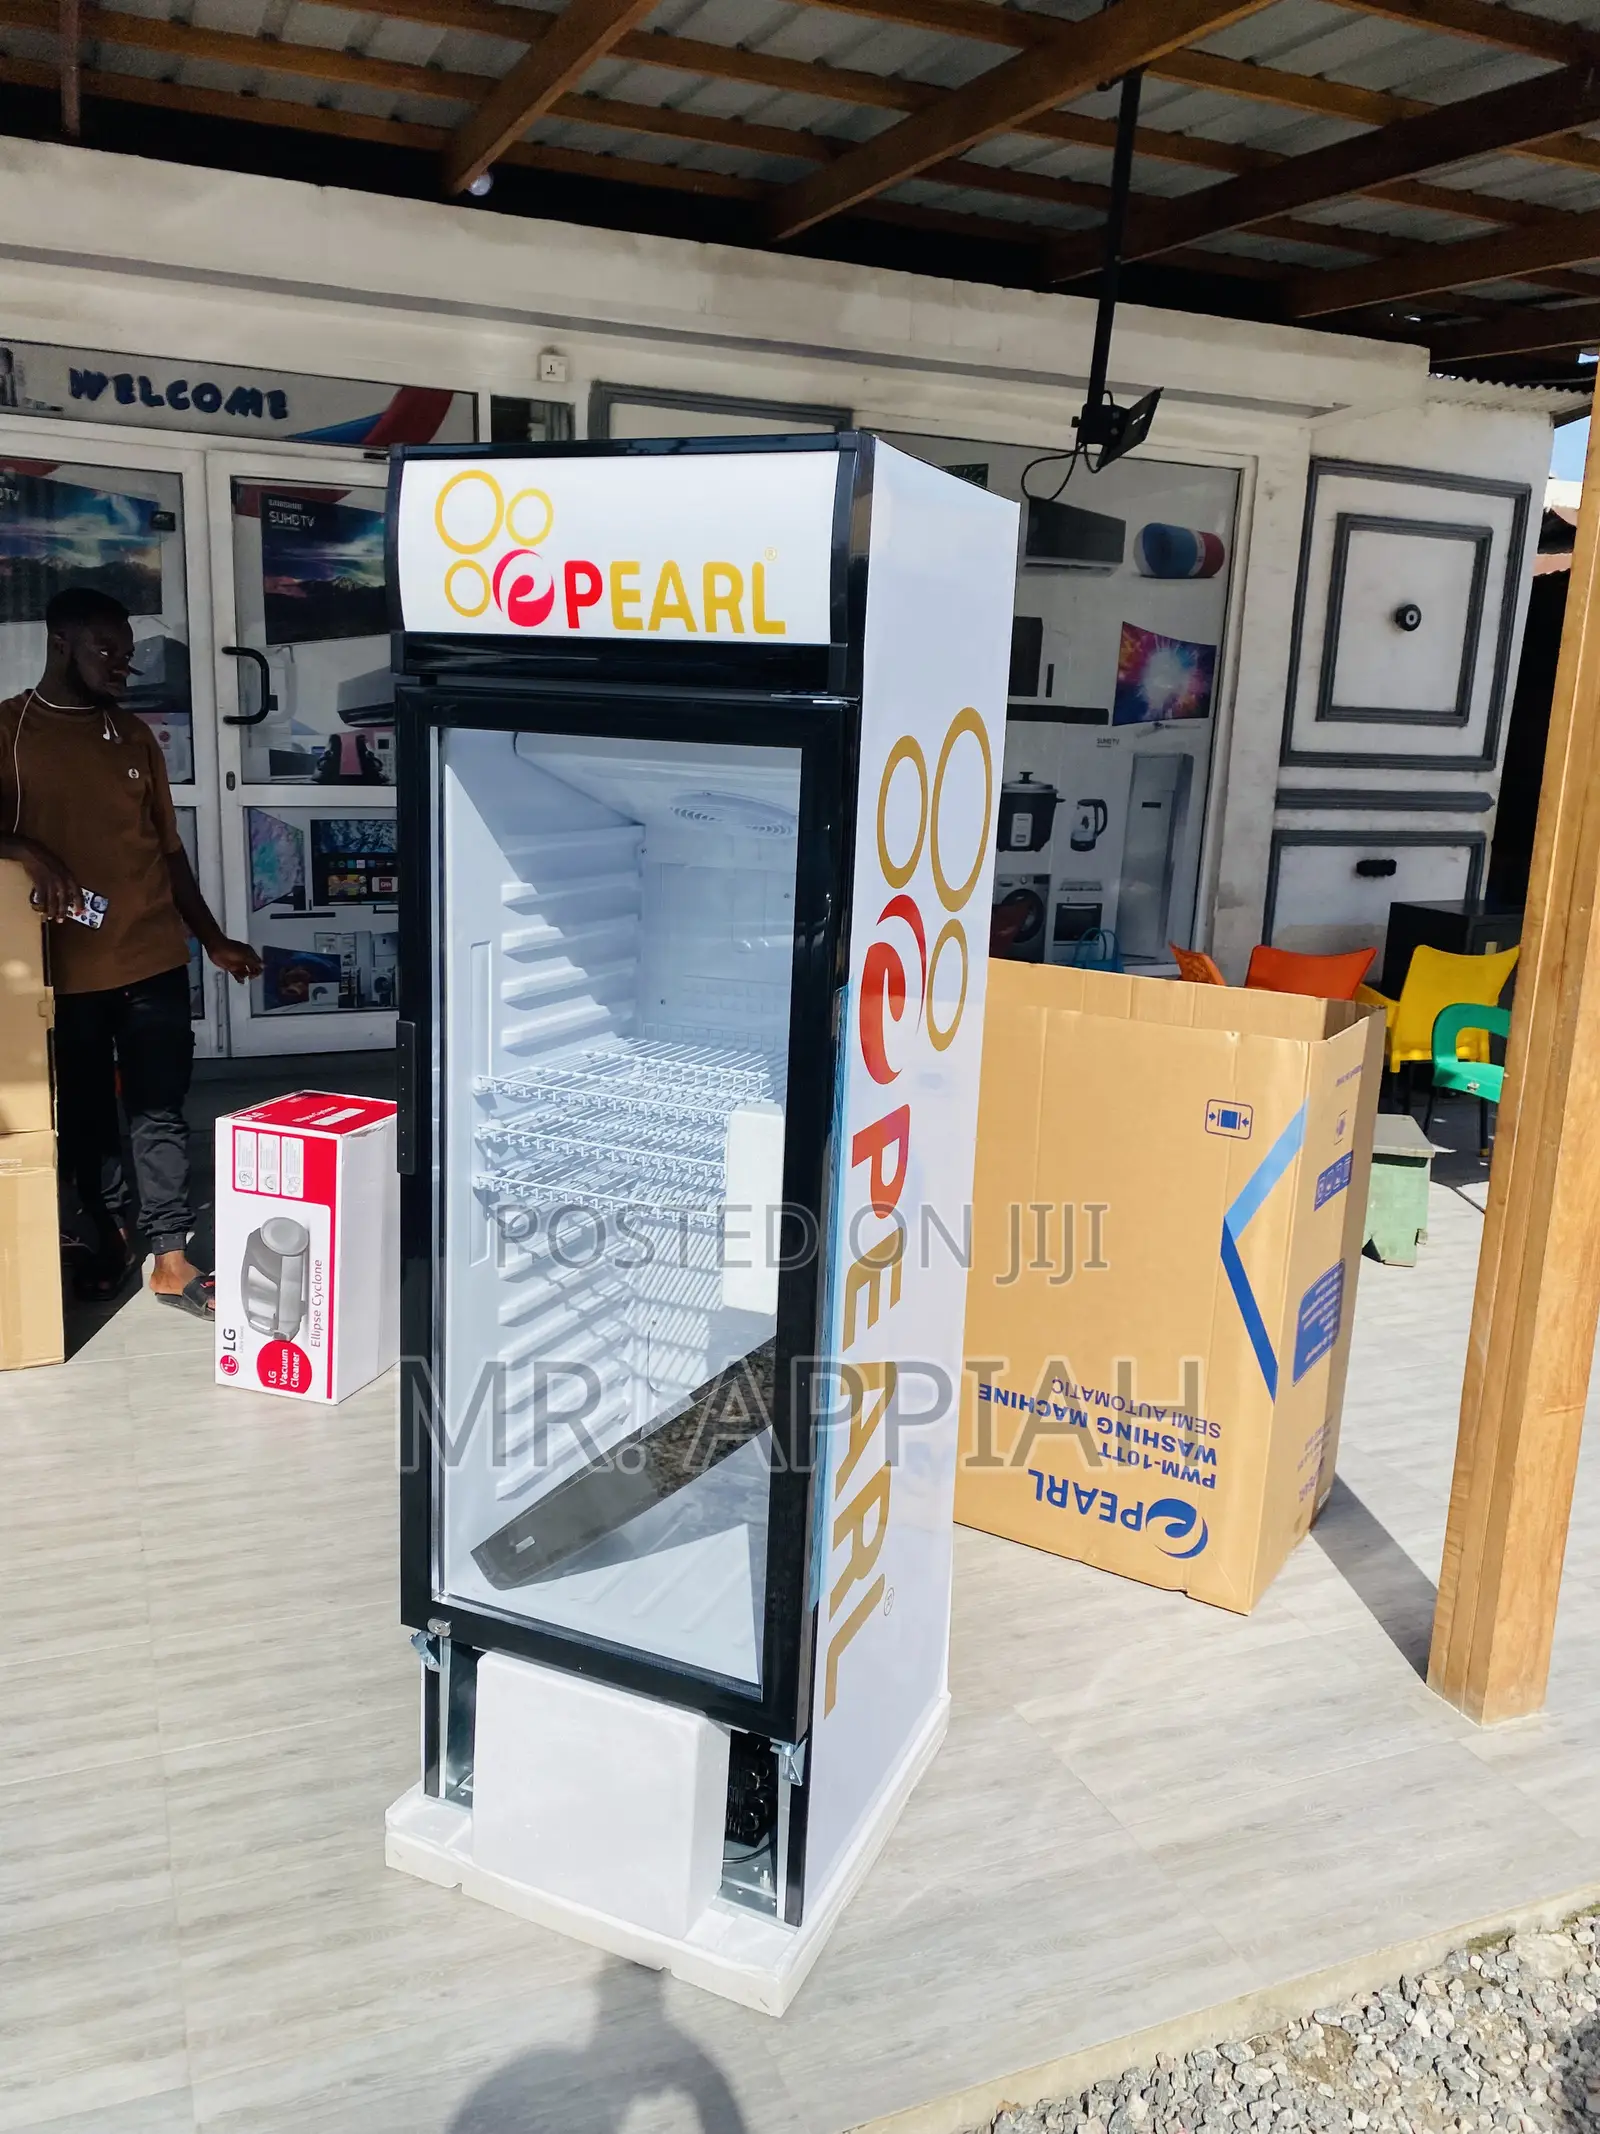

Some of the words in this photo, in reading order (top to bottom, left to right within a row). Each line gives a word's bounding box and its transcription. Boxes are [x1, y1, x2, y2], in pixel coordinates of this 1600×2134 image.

[69, 367, 289, 420] WELCOME
[563, 559, 787, 635] PEARL
[311, 1259, 324, 1307] Cyclone
[223, 1328, 236, 1352] LG
[311, 1310, 324, 1348] Ellipse
[268, 1370, 277, 1384] LG
[279, 1349, 289, 1386] Vacuum
[290, 1351, 300, 1388] Cleaner
[978, 1383, 1088, 1429] MACHINE
[1051, 1377, 1167, 1420] AUTOMATIC
[1096, 1416, 1218, 1467] WASHING
[1171, 1412, 1222, 1439] SEMI
[1097, 1447, 1217, 1490] PWM-10TT
[1027, 1468, 1145, 1532] PEARL
